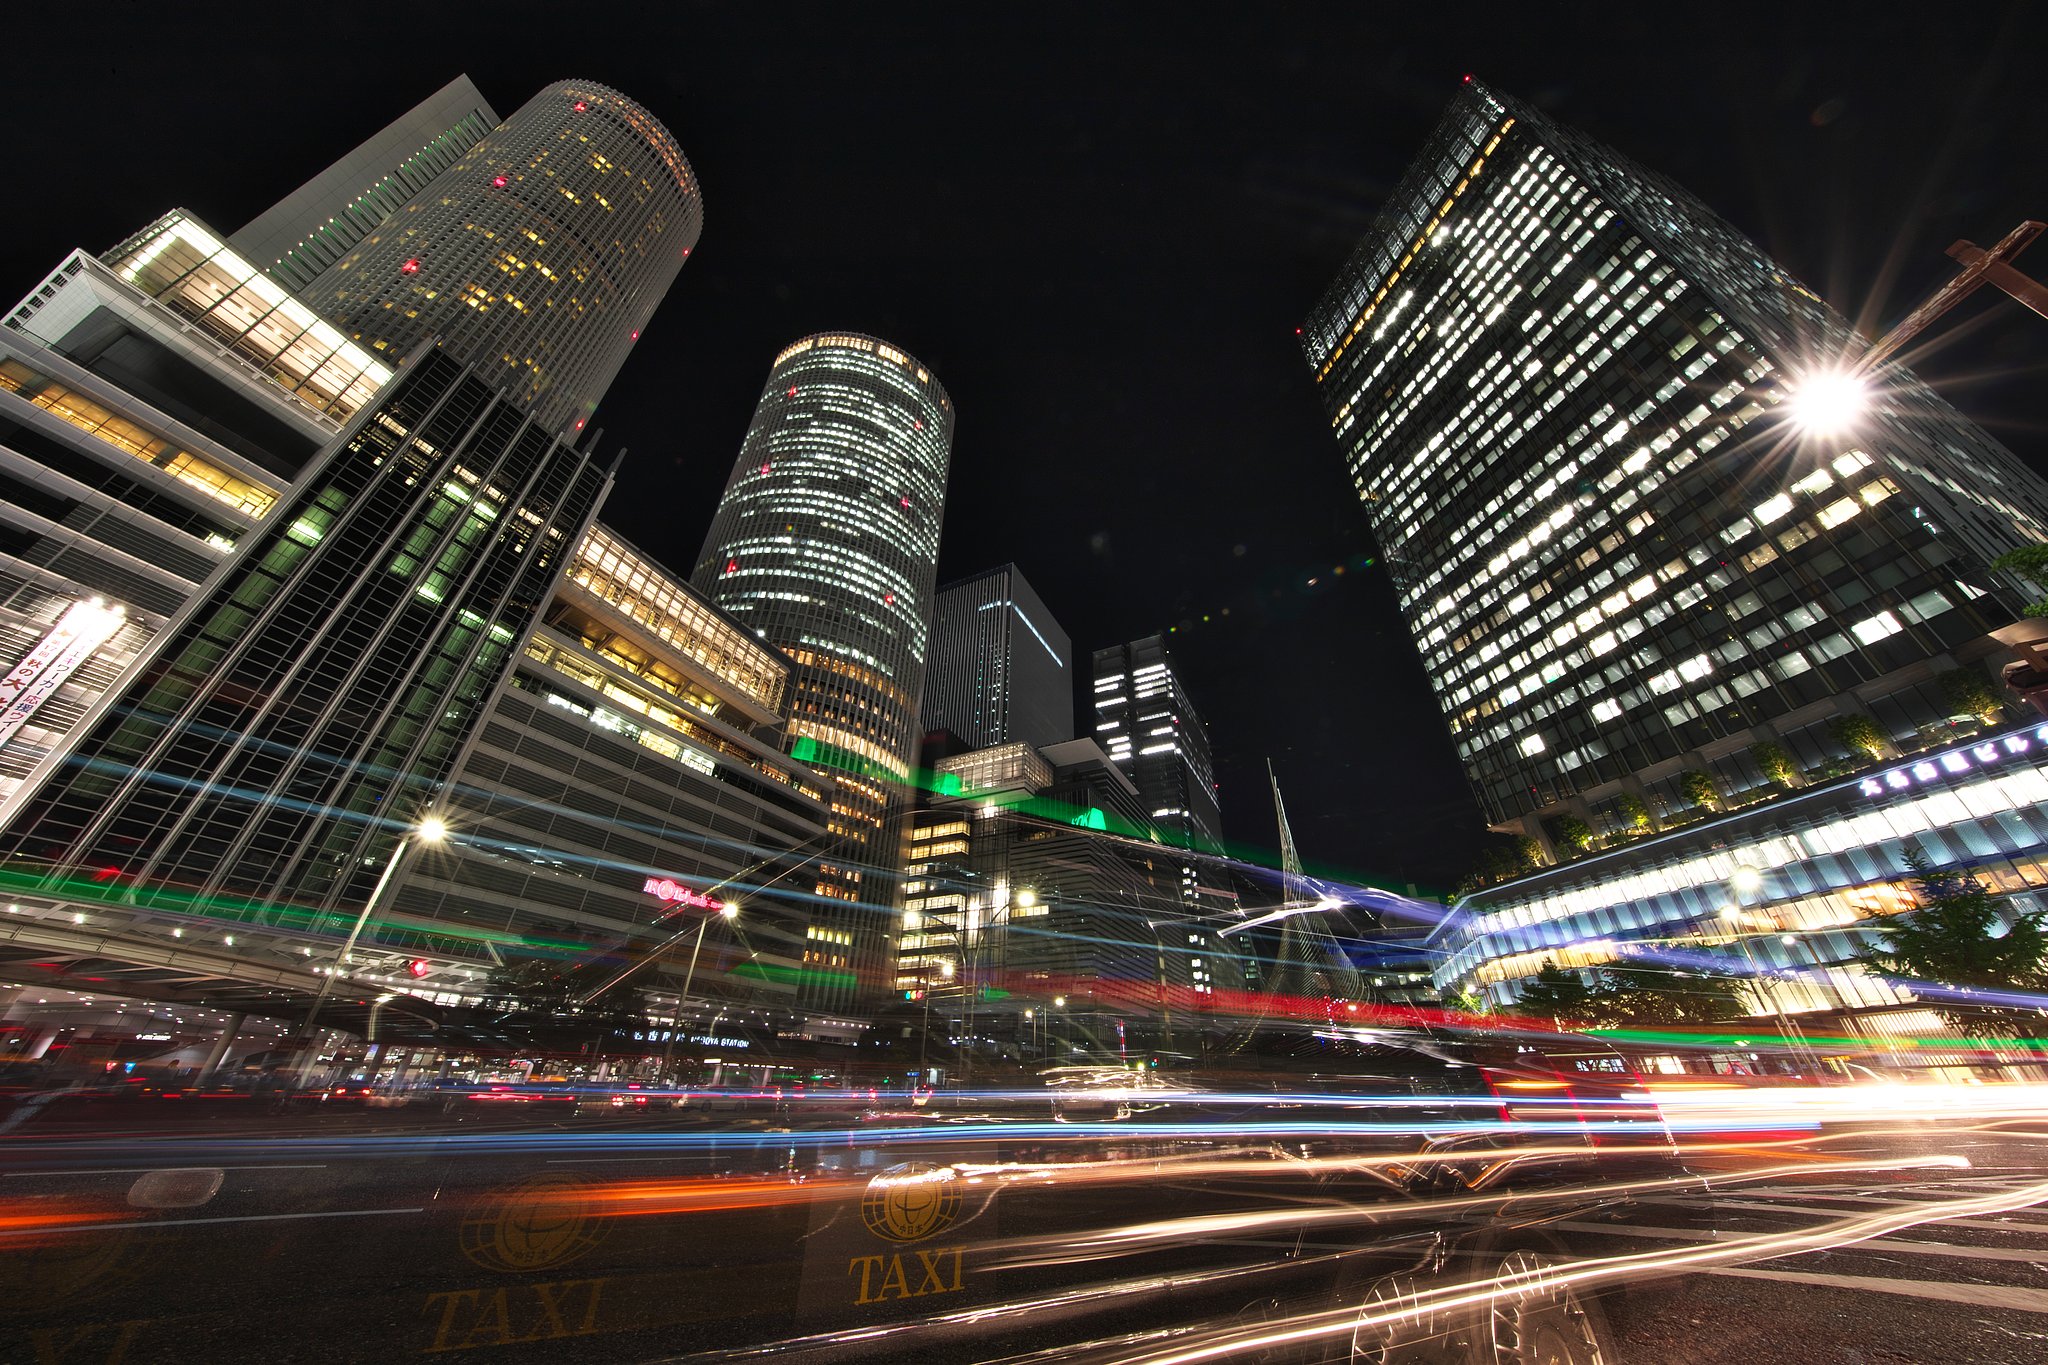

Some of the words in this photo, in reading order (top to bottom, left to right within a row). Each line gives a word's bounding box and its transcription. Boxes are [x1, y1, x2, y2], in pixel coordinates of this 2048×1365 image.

[720, 1039, 750, 1048] STATION
[848, 1245, 968, 1306] TAXI
[420, 1277, 607, 1353] TAXI
